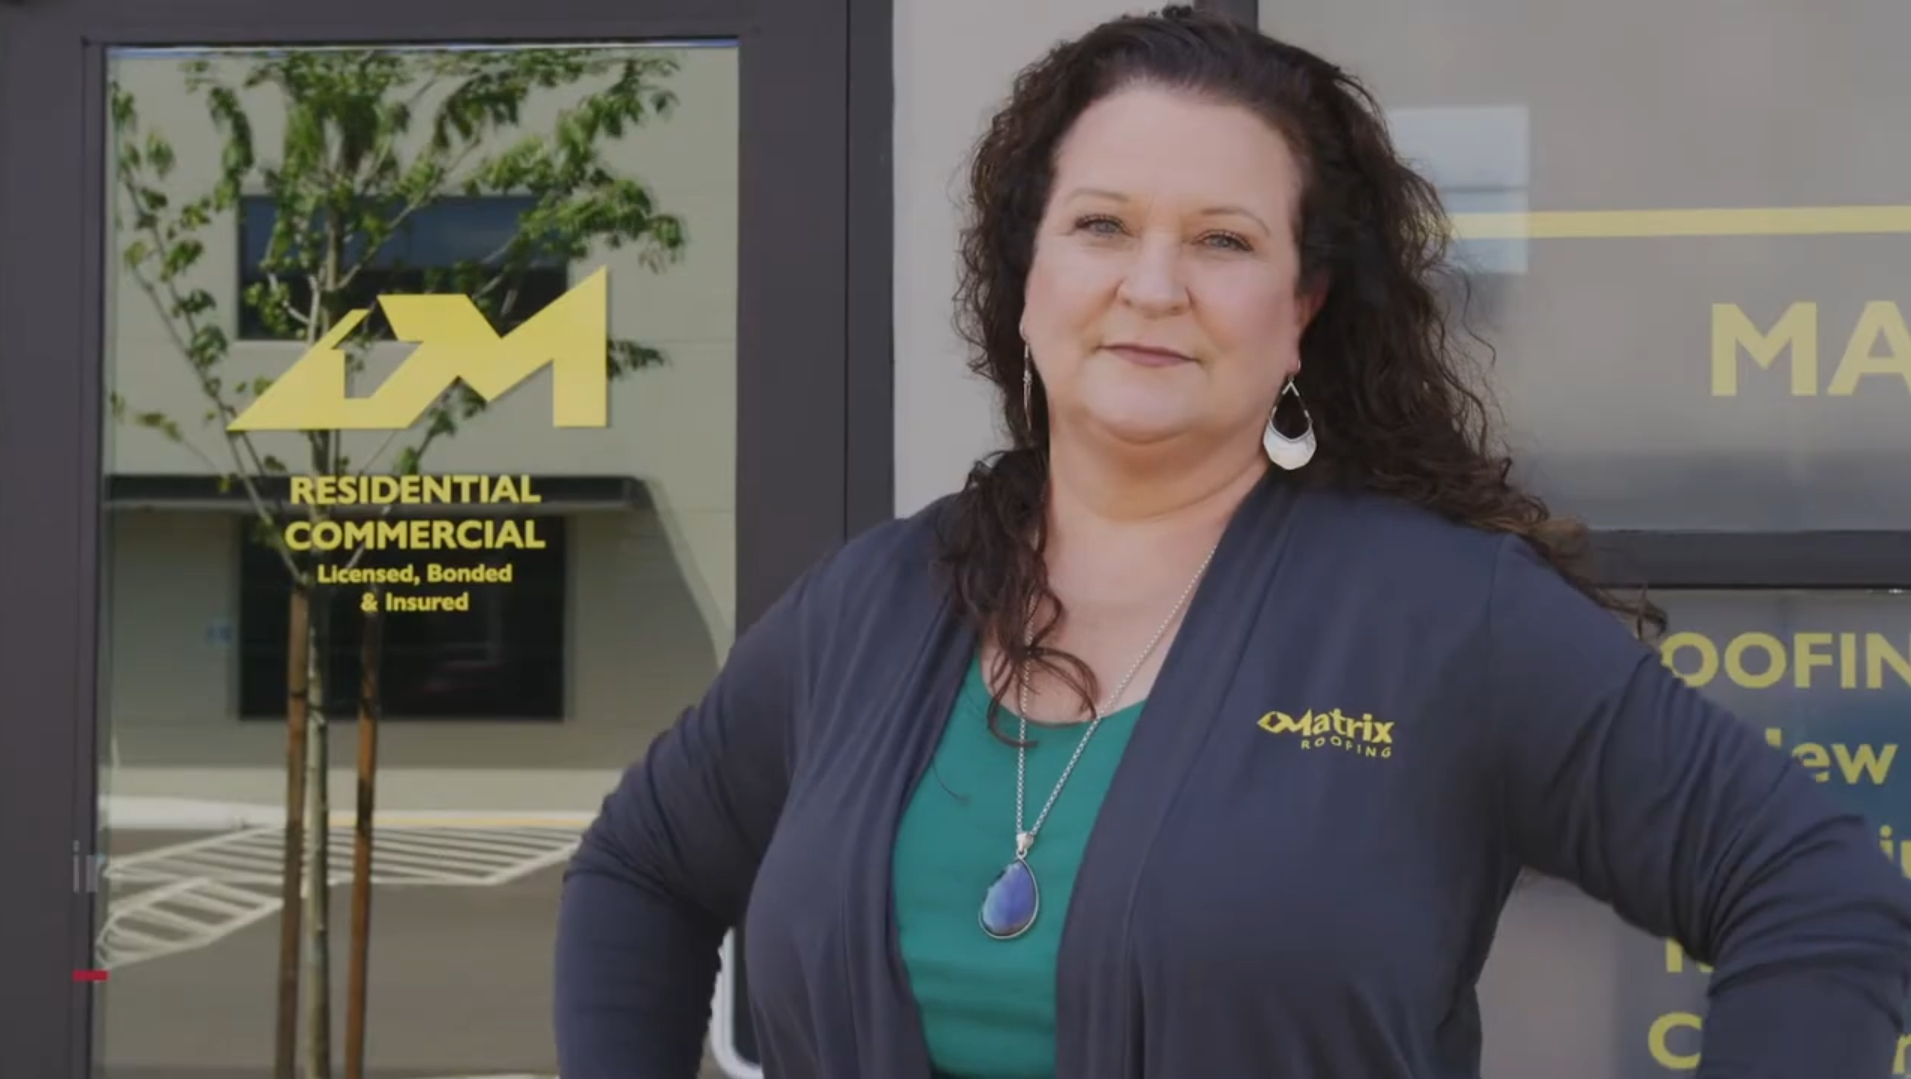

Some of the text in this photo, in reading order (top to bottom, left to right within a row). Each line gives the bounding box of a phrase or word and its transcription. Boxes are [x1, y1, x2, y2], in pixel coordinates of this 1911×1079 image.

[1711, 300, 1911, 396] MA
[289, 474, 542, 505] RESIDENTIAL
[284, 519, 546, 550] COMMERCIAL
[317, 563, 513, 585] Licensed, Bonded
[360, 591, 470, 612] & Insured
[1257, 708, 1394, 744] Matrix
[1301, 735, 1392, 759] ROOFING
[1765, 727, 1898, 784] ew
